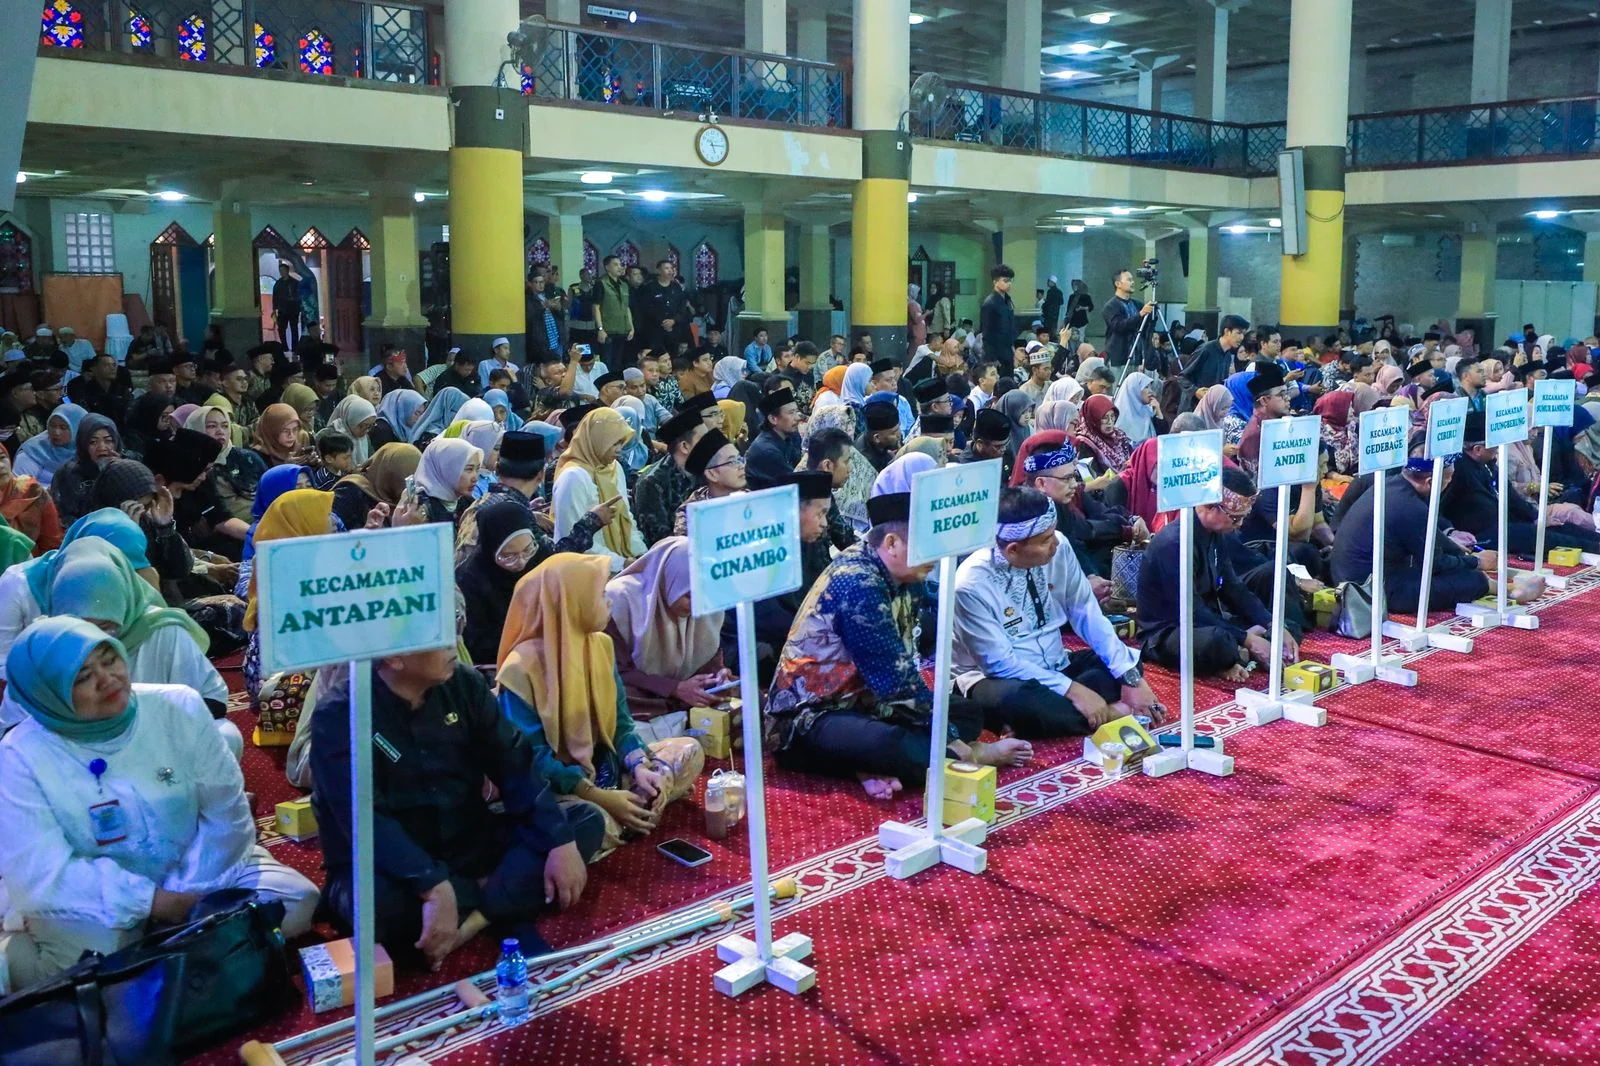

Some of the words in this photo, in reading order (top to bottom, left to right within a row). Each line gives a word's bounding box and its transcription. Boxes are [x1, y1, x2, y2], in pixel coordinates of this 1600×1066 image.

[1495, 406, 1523, 418] KECAMATAN
[1437, 416, 1462, 427] KECAMATAN
[1370, 425, 1403, 439] KECAMATAN
[1437, 429, 1458, 441] CIBIRU
[1272, 437, 1312, 450] KECAMATAN
[1365, 439, 1404, 455] GEDEBAGE
[1274, 453, 1306, 467] ANDIR
[930, 489, 989, 512] KECAMATAN
[933, 511, 980, 534] REGOL
[716, 522, 785, 551] KECAMATAN
[710, 546, 788, 580] CINAMBO
[299, 565, 425, 597] KECAMATAN
[278, 592, 437, 634] ANTAPANI
